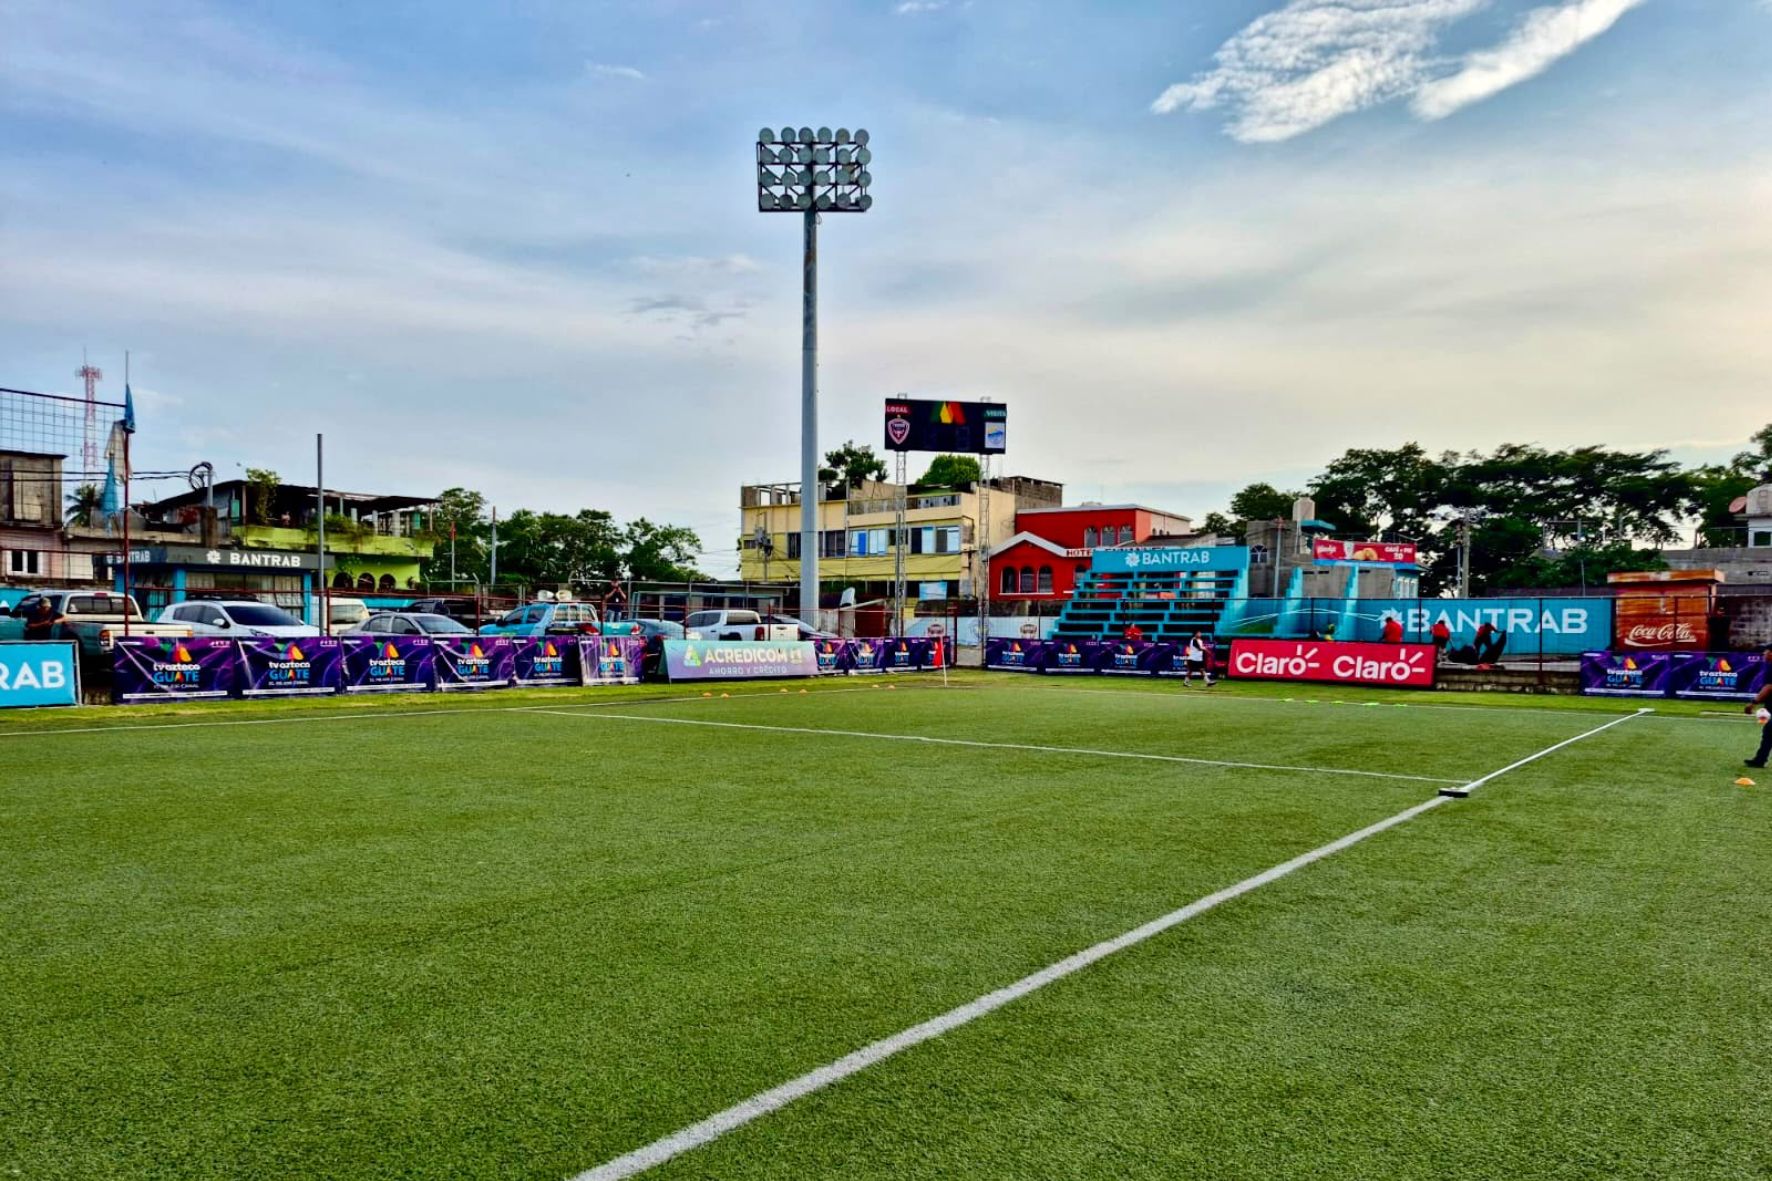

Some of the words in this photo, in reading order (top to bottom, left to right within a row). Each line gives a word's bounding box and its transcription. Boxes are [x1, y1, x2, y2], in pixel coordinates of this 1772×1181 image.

[230, 553, 301, 567] BANTRAB
[1142, 551, 1210, 565] BANTRAB
[1407, 608, 1588, 633] BANTRAB
[1629, 623, 1691, 641] Coca-Cola
[704, 648, 788, 663] ACREDICOM
[709, 666, 744, 675] AHORRO
[1236, 652, 1306, 675] Claro
[1333, 655, 1411, 681] Claro
[153, 671, 200, 682] GUATE
[269, 669, 310, 680] GUATE
[370, 666, 405, 676] GUATE
[1700, 676, 1737, 685] GUATE
